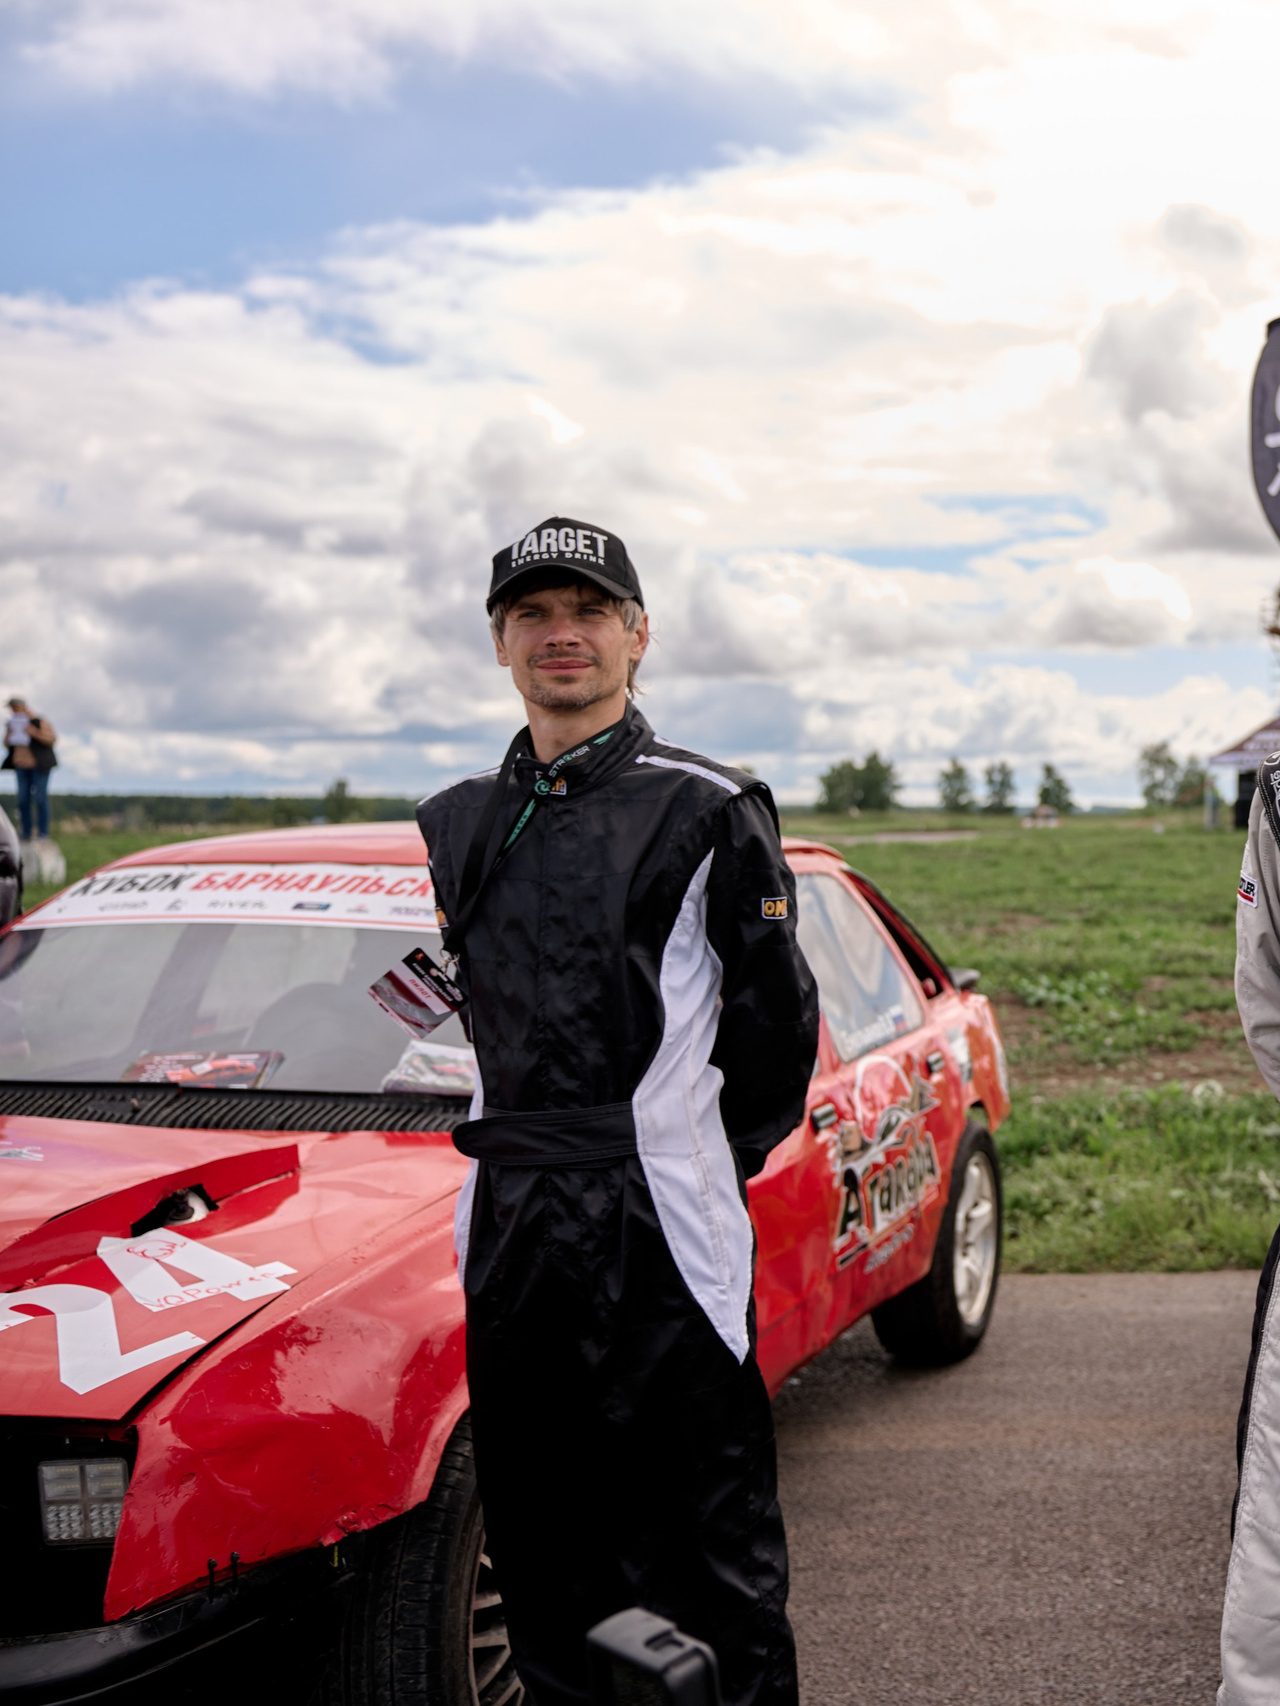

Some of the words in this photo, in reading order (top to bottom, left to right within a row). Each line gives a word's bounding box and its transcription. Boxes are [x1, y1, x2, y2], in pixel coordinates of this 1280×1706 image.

[511, 527, 608, 560] TARGET
[511, 552, 559, 568] ENERGY
[565, 552, 605, 566] DRINK
[69, 873, 199, 898] КУБОК
[190, 871, 436, 898] БАРНАУЛЬСК
[764, 900, 787, 917] OM
[408, 978, 433, 999] ПИЛОТ
